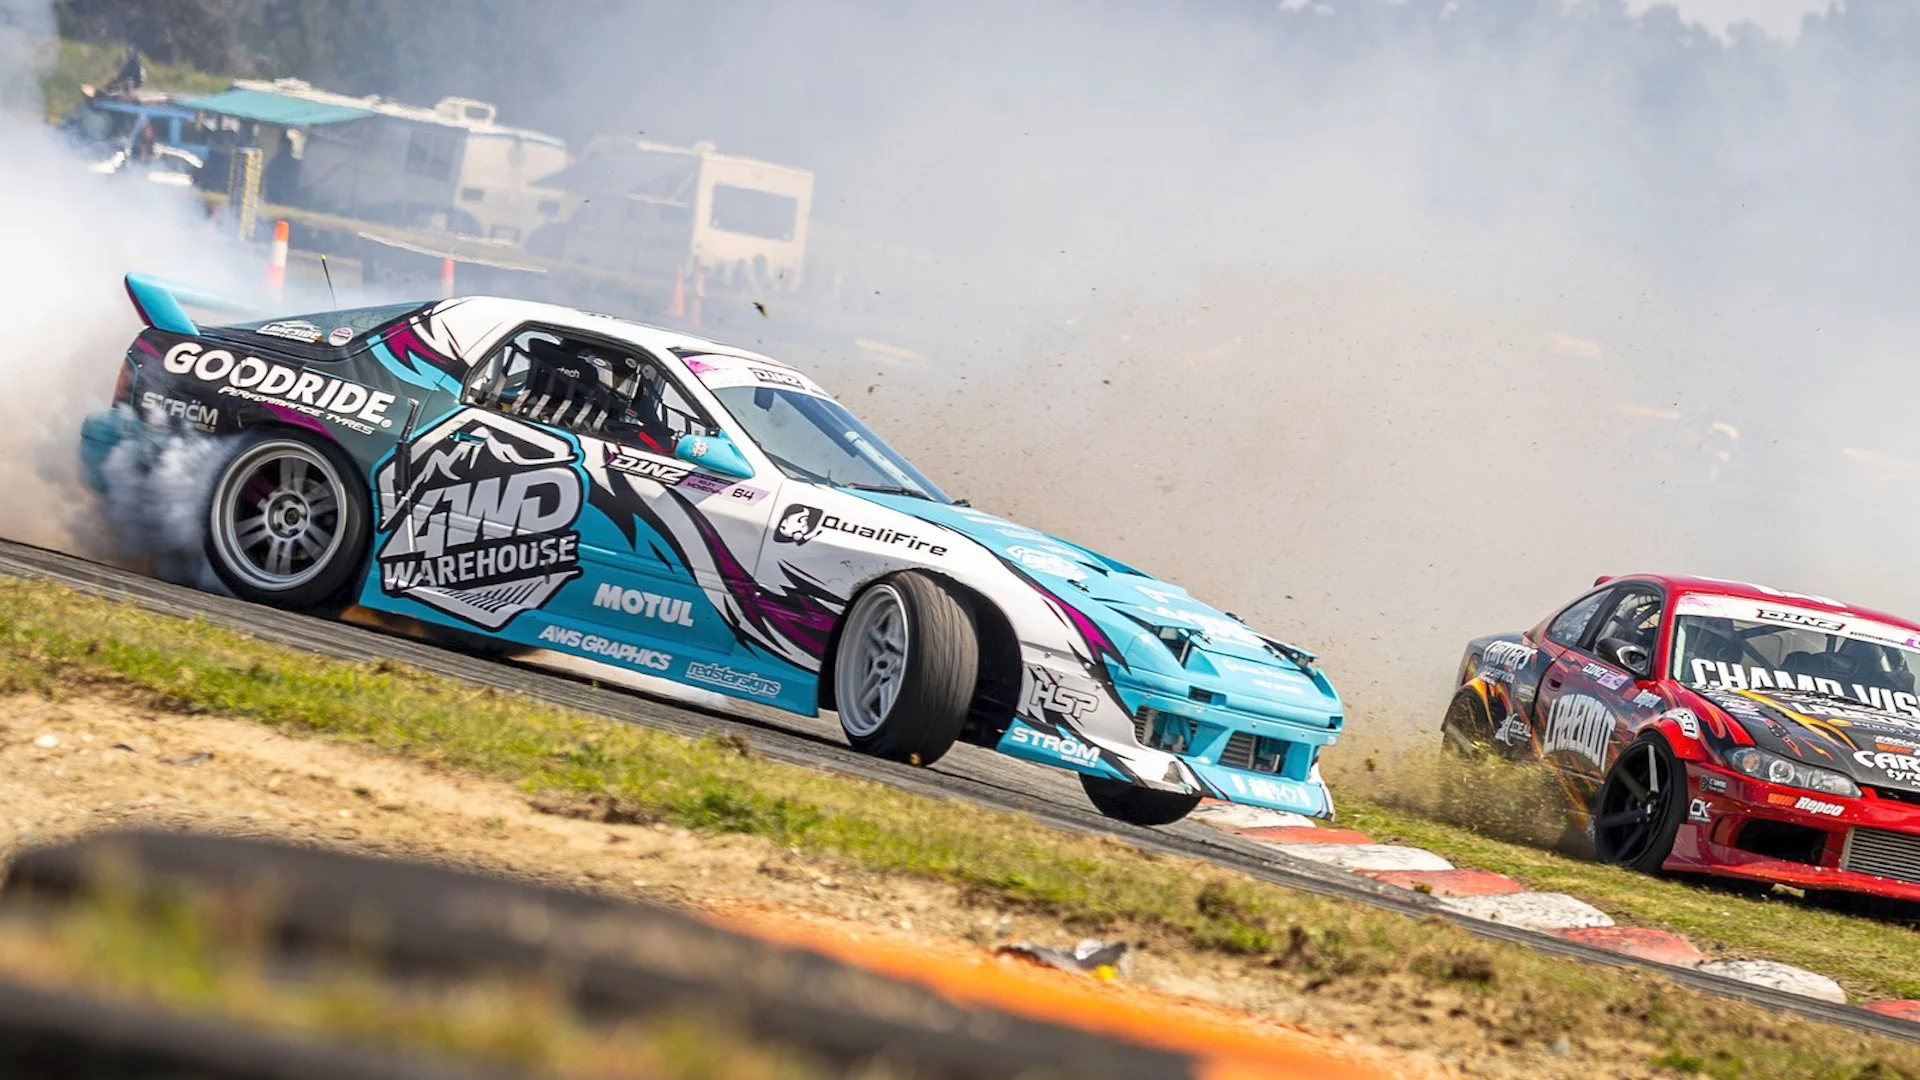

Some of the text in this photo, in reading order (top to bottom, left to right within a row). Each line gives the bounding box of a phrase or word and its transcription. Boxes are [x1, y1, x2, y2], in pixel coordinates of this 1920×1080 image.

[163, 342, 396, 426] GOODRIDE
[218, 386, 376, 436] PERFORMANCE TYRES
[610, 454, 690, 484] D1NZ
[380, 466, 580, 558] 4WD
[732, 488, 756, 501] 64
[820, 515, 949, 557] QualiFire
[383, 534, 578, 591] WAREHOUSE
[592, 583, 694, 628] MOTUL
[1758, 608, 1846, 632] D1NZ
[538, 625, 672, 671] AWS GRAPHICS
[686, 661, 781, 695] redstarsigns
[1030, 680, 1099, 718] HSP
[1852, 683, 1920, 720] VIS
[1853, 750, 1920, 773] CAR
[1794, 797, 1845, 816] Repco
